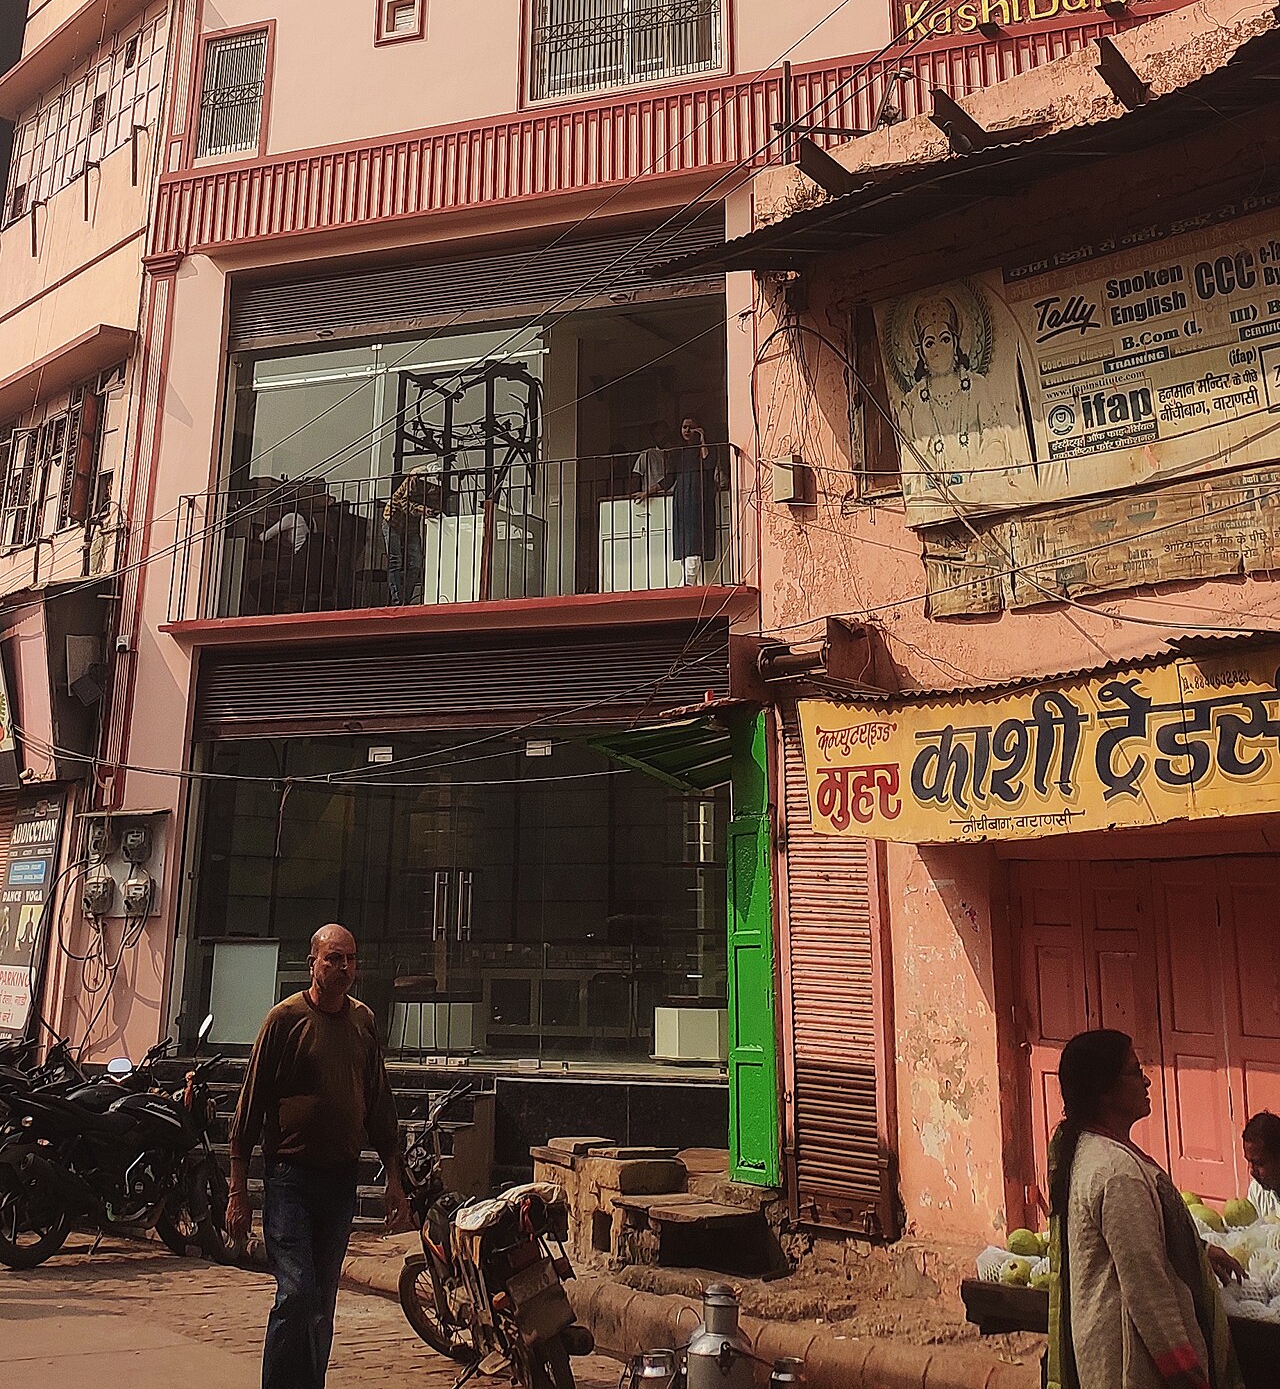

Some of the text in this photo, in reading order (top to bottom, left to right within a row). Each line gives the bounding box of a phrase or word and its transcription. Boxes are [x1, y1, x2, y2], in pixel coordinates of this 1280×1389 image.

[1009, 261, 1049, 279] काम
[1106, 265, 1184, 299] Spoken
[1194, 251, 1255, 300] CCC
[1033, 296, 1099, 339] Tally
[1111, 291, 1187, 326] English
[1121, 329, 1180, 350] B.Com
[1108, 351, 1165, 371] TRAINING
[1229, 346, 1257, 367] (ifap)
[1046, 369, 1147, 400] www.ifapinstitute.com
[1081, 387, 1152, 429] ifap
[911, 691, 1090, 811] काशी
[816, 763, 902, 831] मुहर
[1015, 808, 1086, 829] वाराणसी
[2, 890, 43, 902] DANCE YOGA
